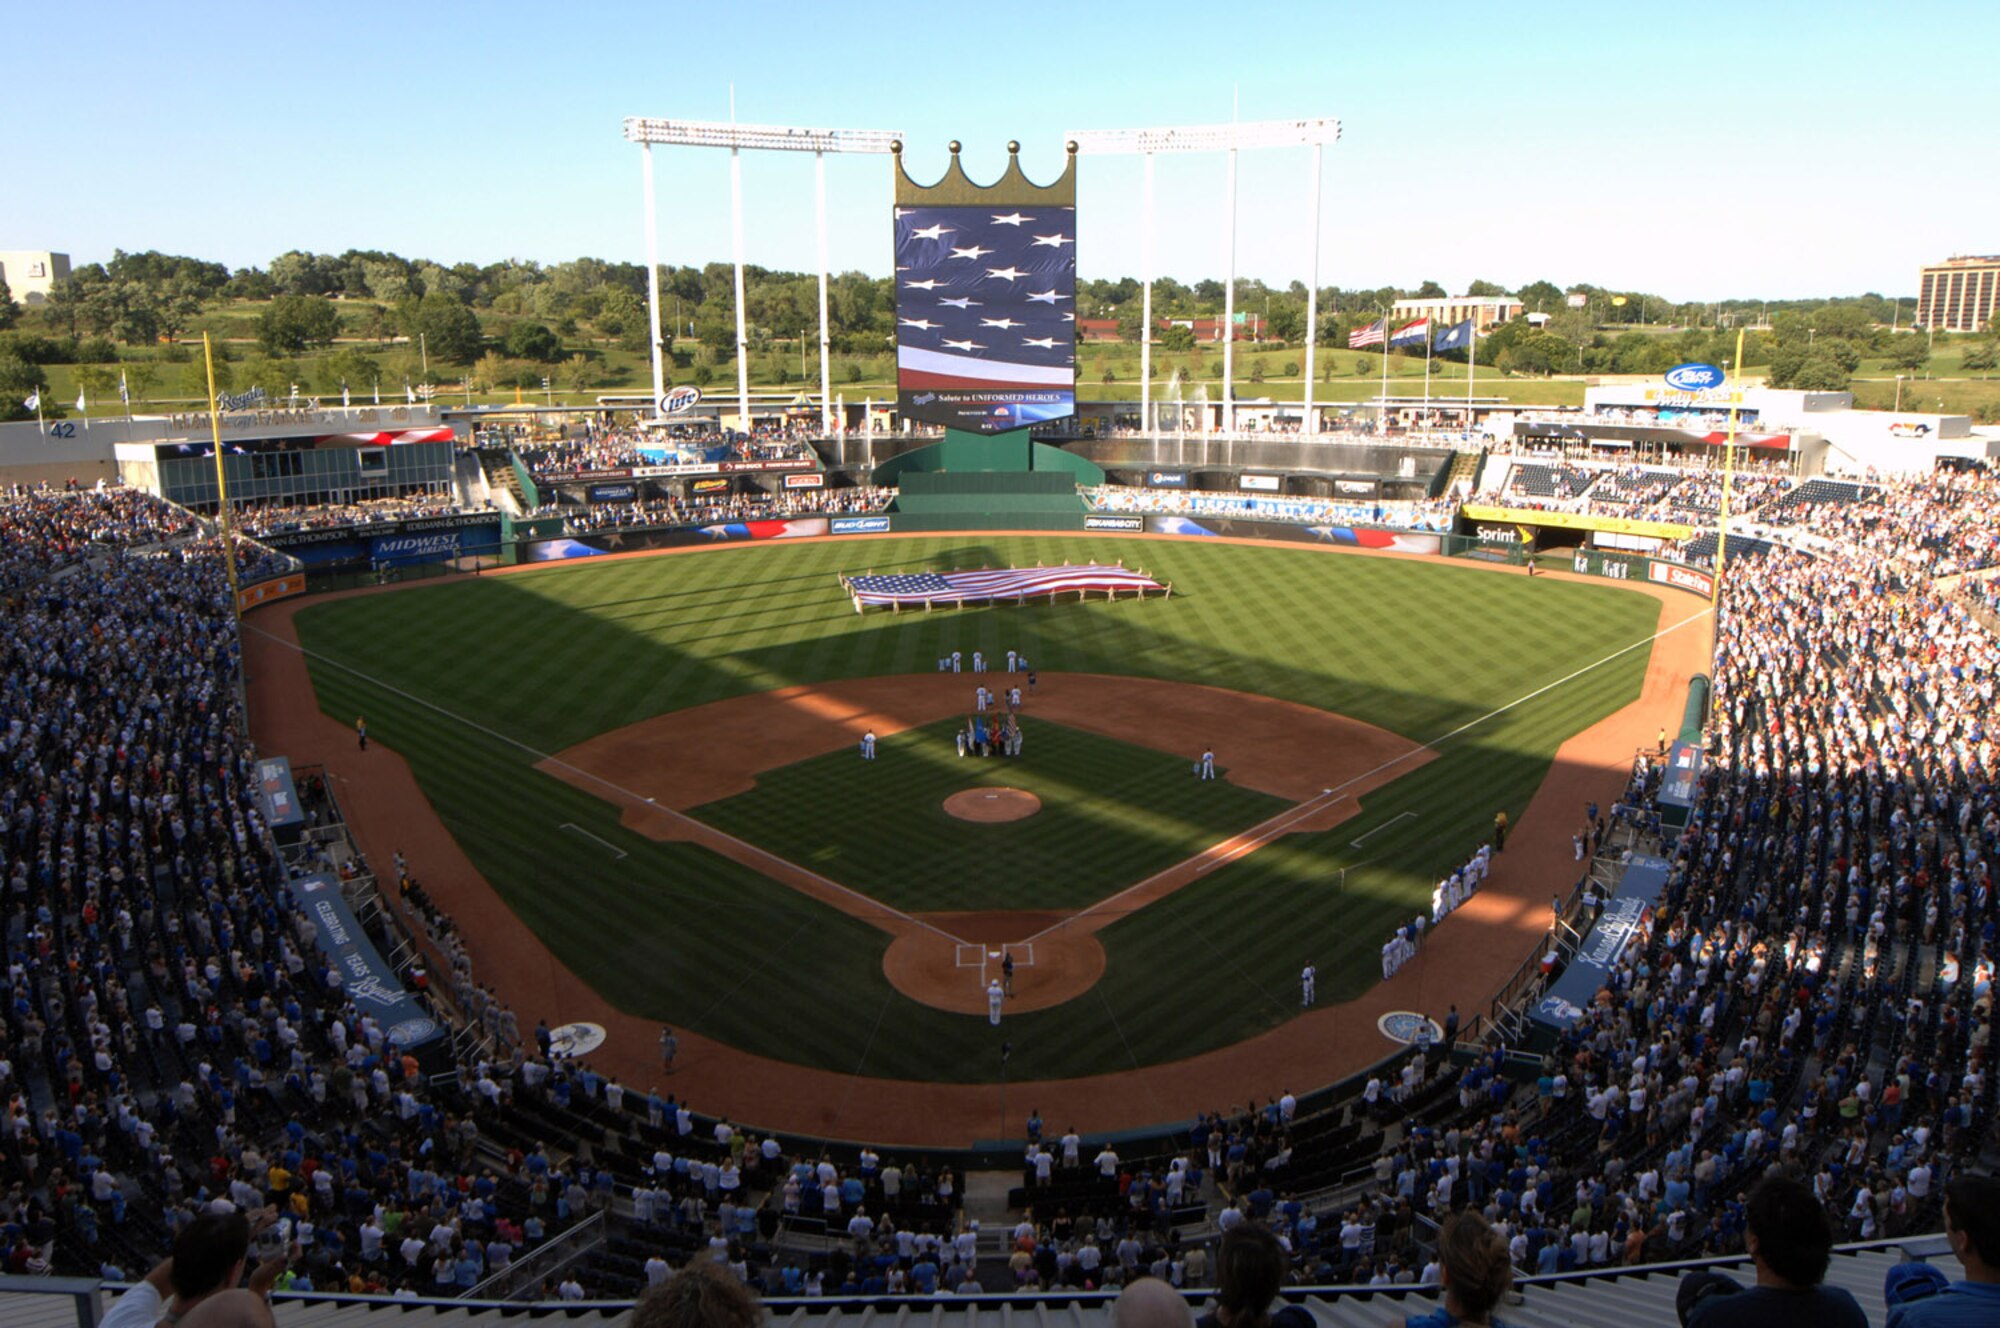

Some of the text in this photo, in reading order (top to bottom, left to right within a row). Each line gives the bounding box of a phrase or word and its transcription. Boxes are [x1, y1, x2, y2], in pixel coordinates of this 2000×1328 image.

[217, 384, 267, 412] Royals
[938, 394, 961, 402] Salute
[1026, 393, 1061, 401] HEROES
[171, 412, 231, 430] HALL
[257, 407, 315, 425] FAME
[51, 422, 76, 439] 42
[1256, 501, 1310, 516] PARTY
[406, 519, 445, 531] EDELMAN
[455, 514, 500, 526] THOMPSON
[834, 521, 856, 529] BUD
[298, 531, 348, 543] THOMPSON
[378, 533, 459, 553] MIDWEST
[1476, 526, 1516, 543] Sprint
[414, 542, 461, 555] AIRLINES
[315, 901, 350, 945] CELEBRATING
[344, 952, 371, 977] YEARS
[348, 975, 406, 1006] Royals
